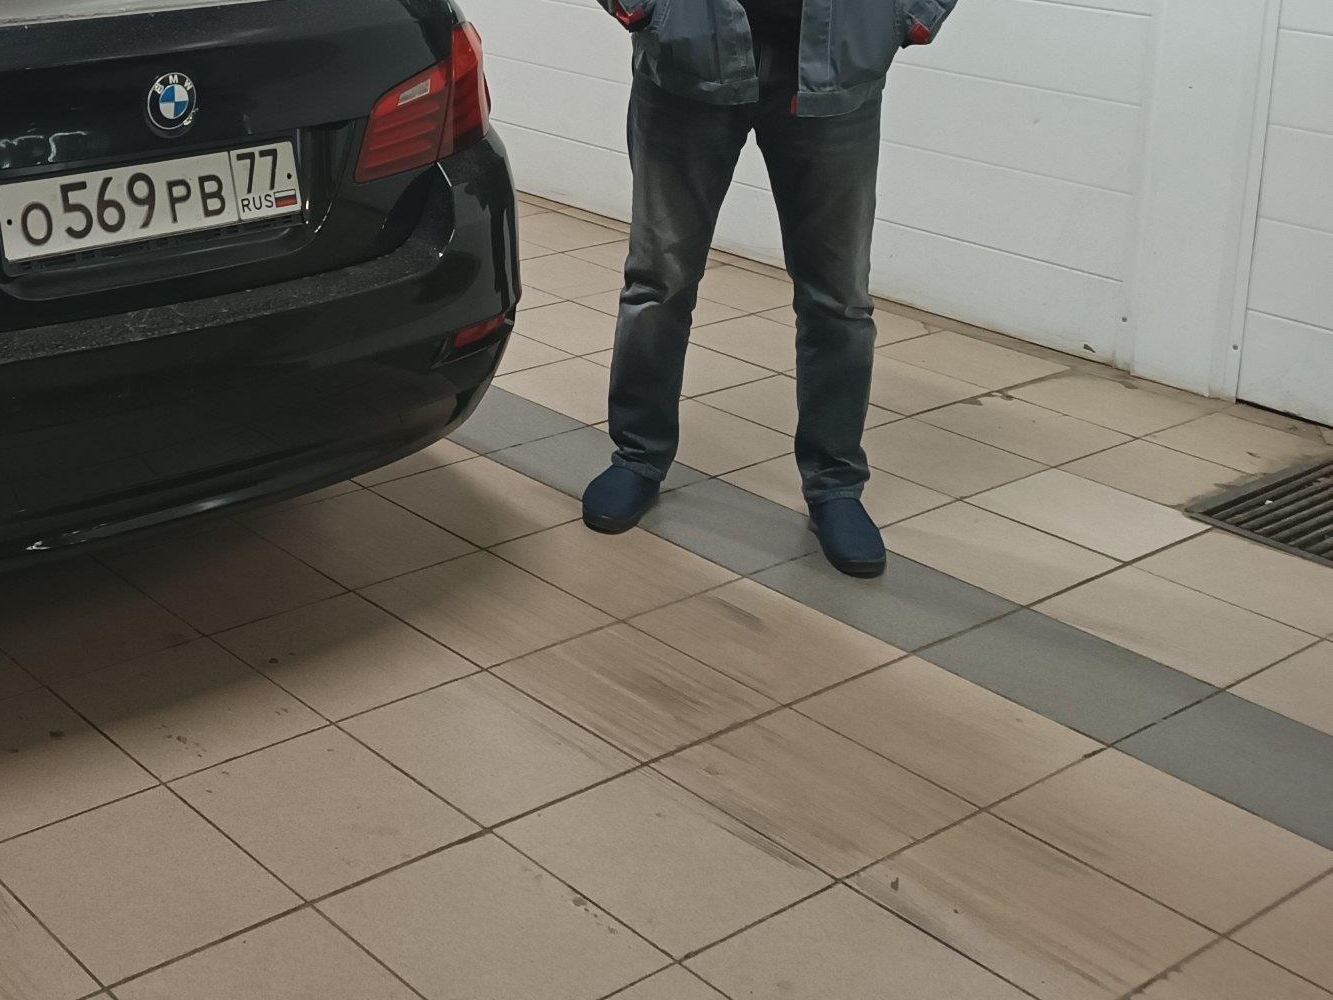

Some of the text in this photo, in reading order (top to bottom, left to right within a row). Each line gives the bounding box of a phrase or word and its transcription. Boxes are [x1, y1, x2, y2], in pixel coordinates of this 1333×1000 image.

[154, 74, 194, 95] BMW
[21, 148, 279, 247] О569РВ 77
[241, 193, 274, 213] RUS
